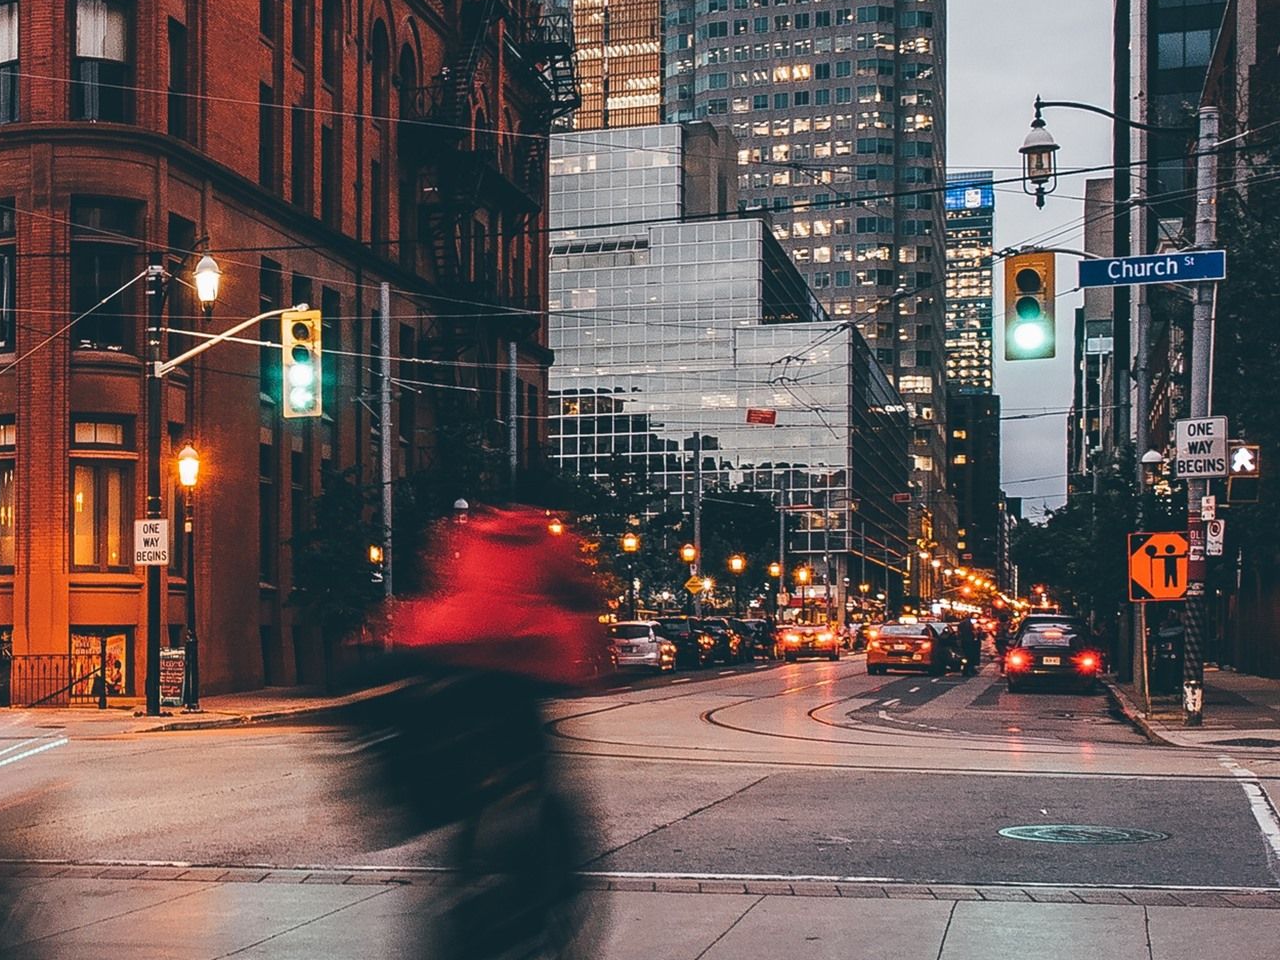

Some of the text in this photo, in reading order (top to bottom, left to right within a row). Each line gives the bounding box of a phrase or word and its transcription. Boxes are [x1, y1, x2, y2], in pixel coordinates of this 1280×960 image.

[1107, 256, 1195, 279] Church St
[1187, 422, 1215, 436] ONE
[1187, 440, 1215, 455] WAY
[1177, 458, 1226, 474] BEGINS
[142, 523, 160, 534] ONE
[143, 537, 160, 548] WAY
[136, 551, 167, 562] BEGINS
